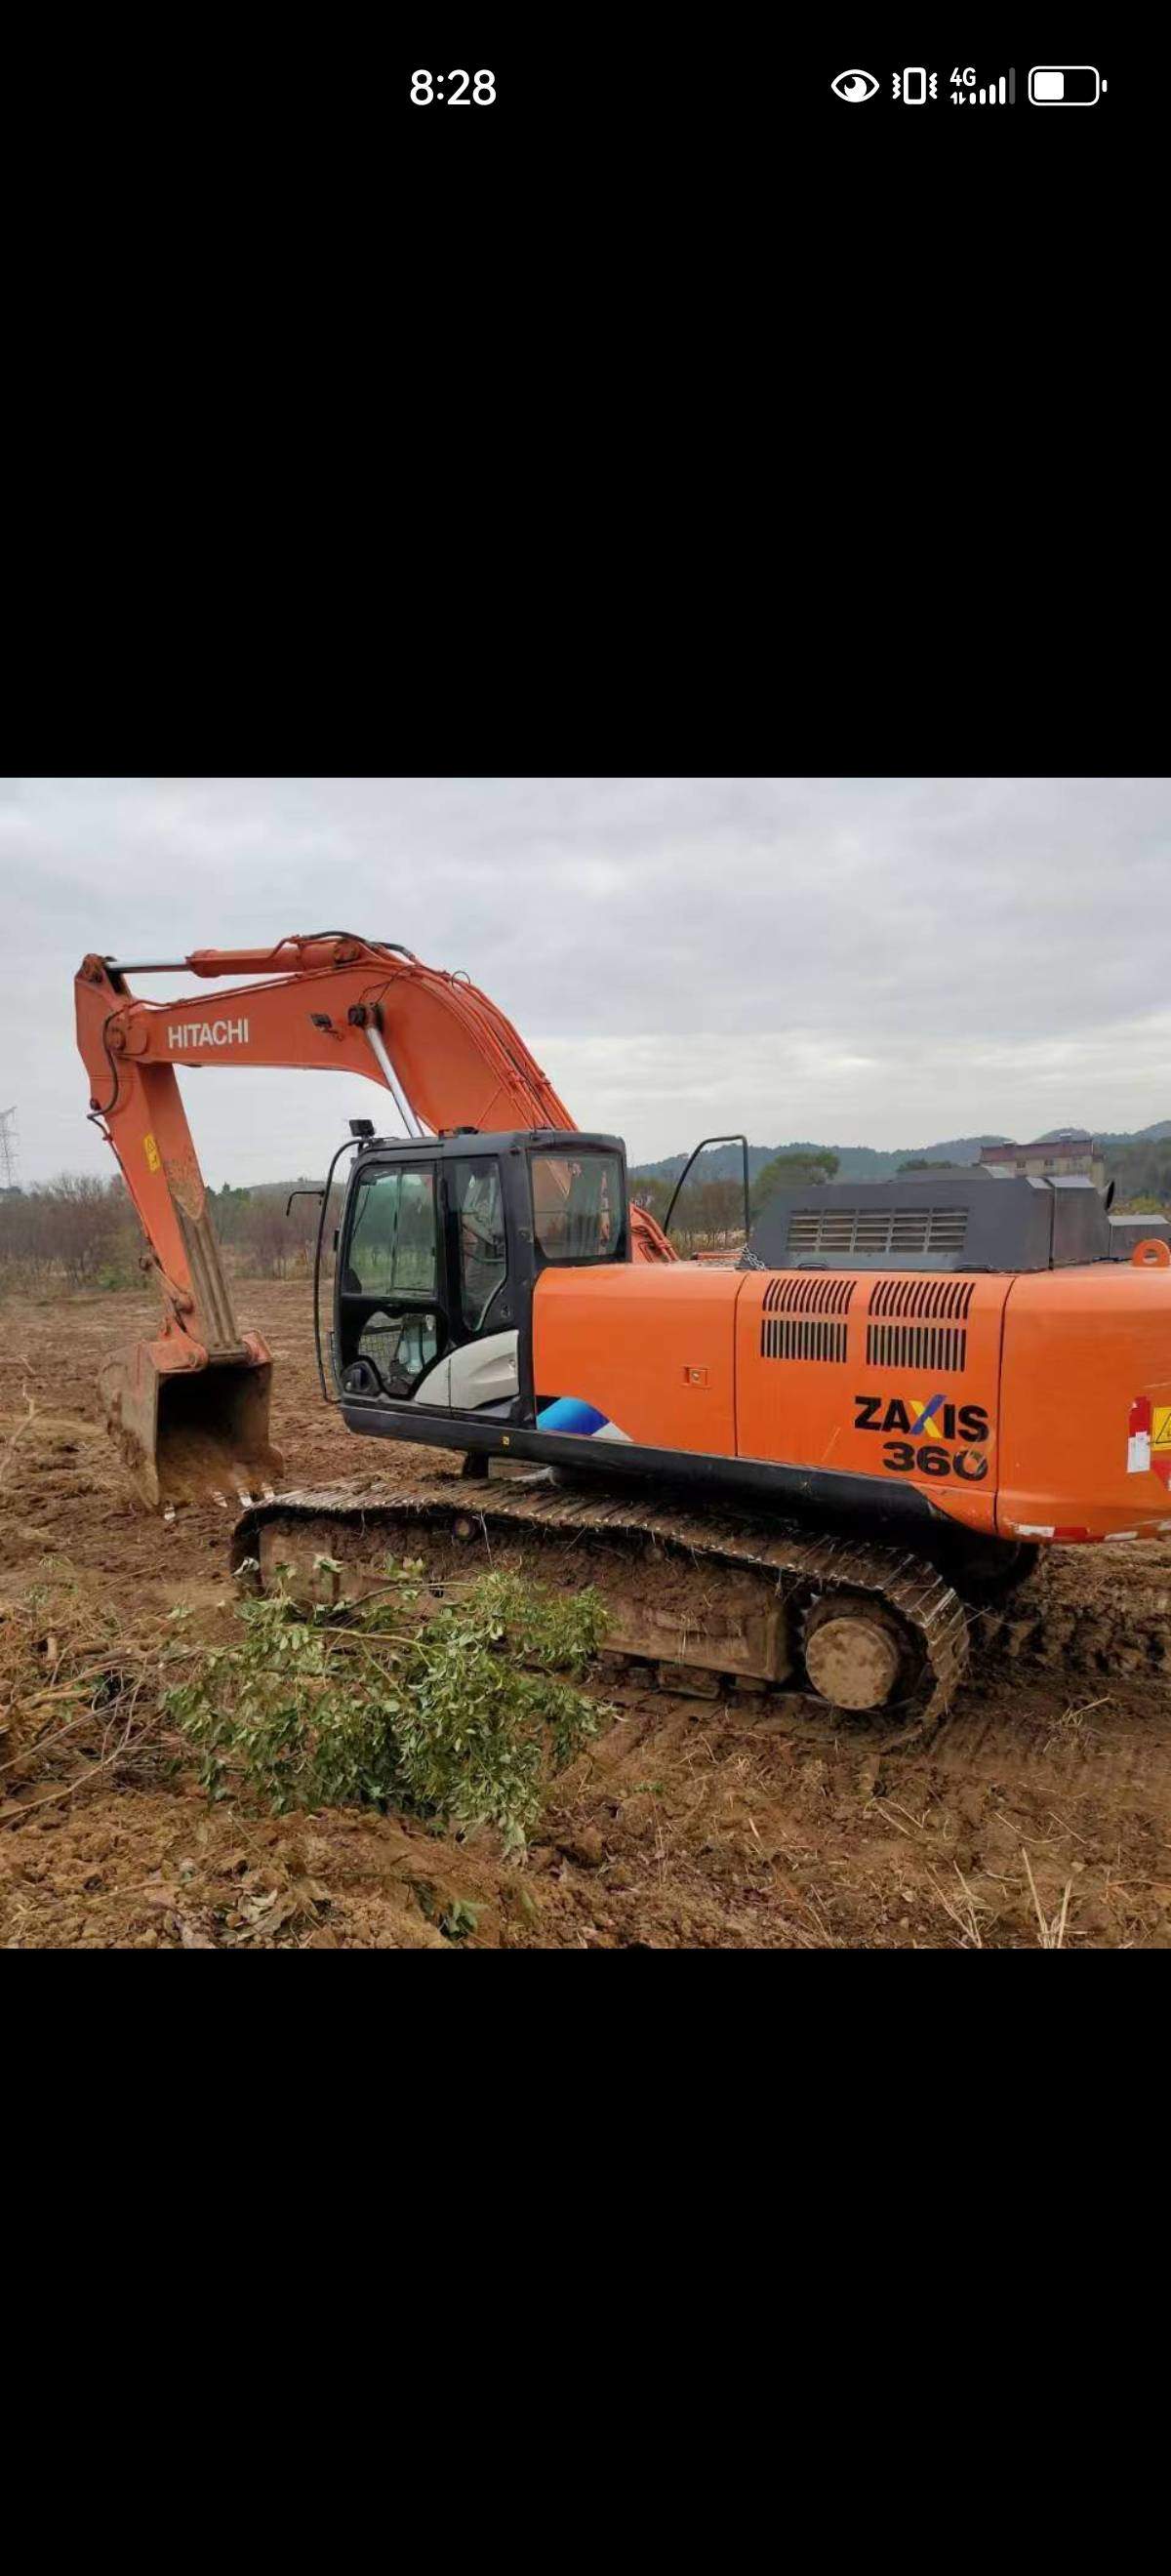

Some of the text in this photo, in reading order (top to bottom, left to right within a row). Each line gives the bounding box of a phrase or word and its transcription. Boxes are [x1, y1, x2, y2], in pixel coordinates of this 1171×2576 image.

[167, 1018, 250, 1049] HITACHI
[854, 1393, 989, 1442] ZAXIS
[882, 1441, 989, 1481] 360
